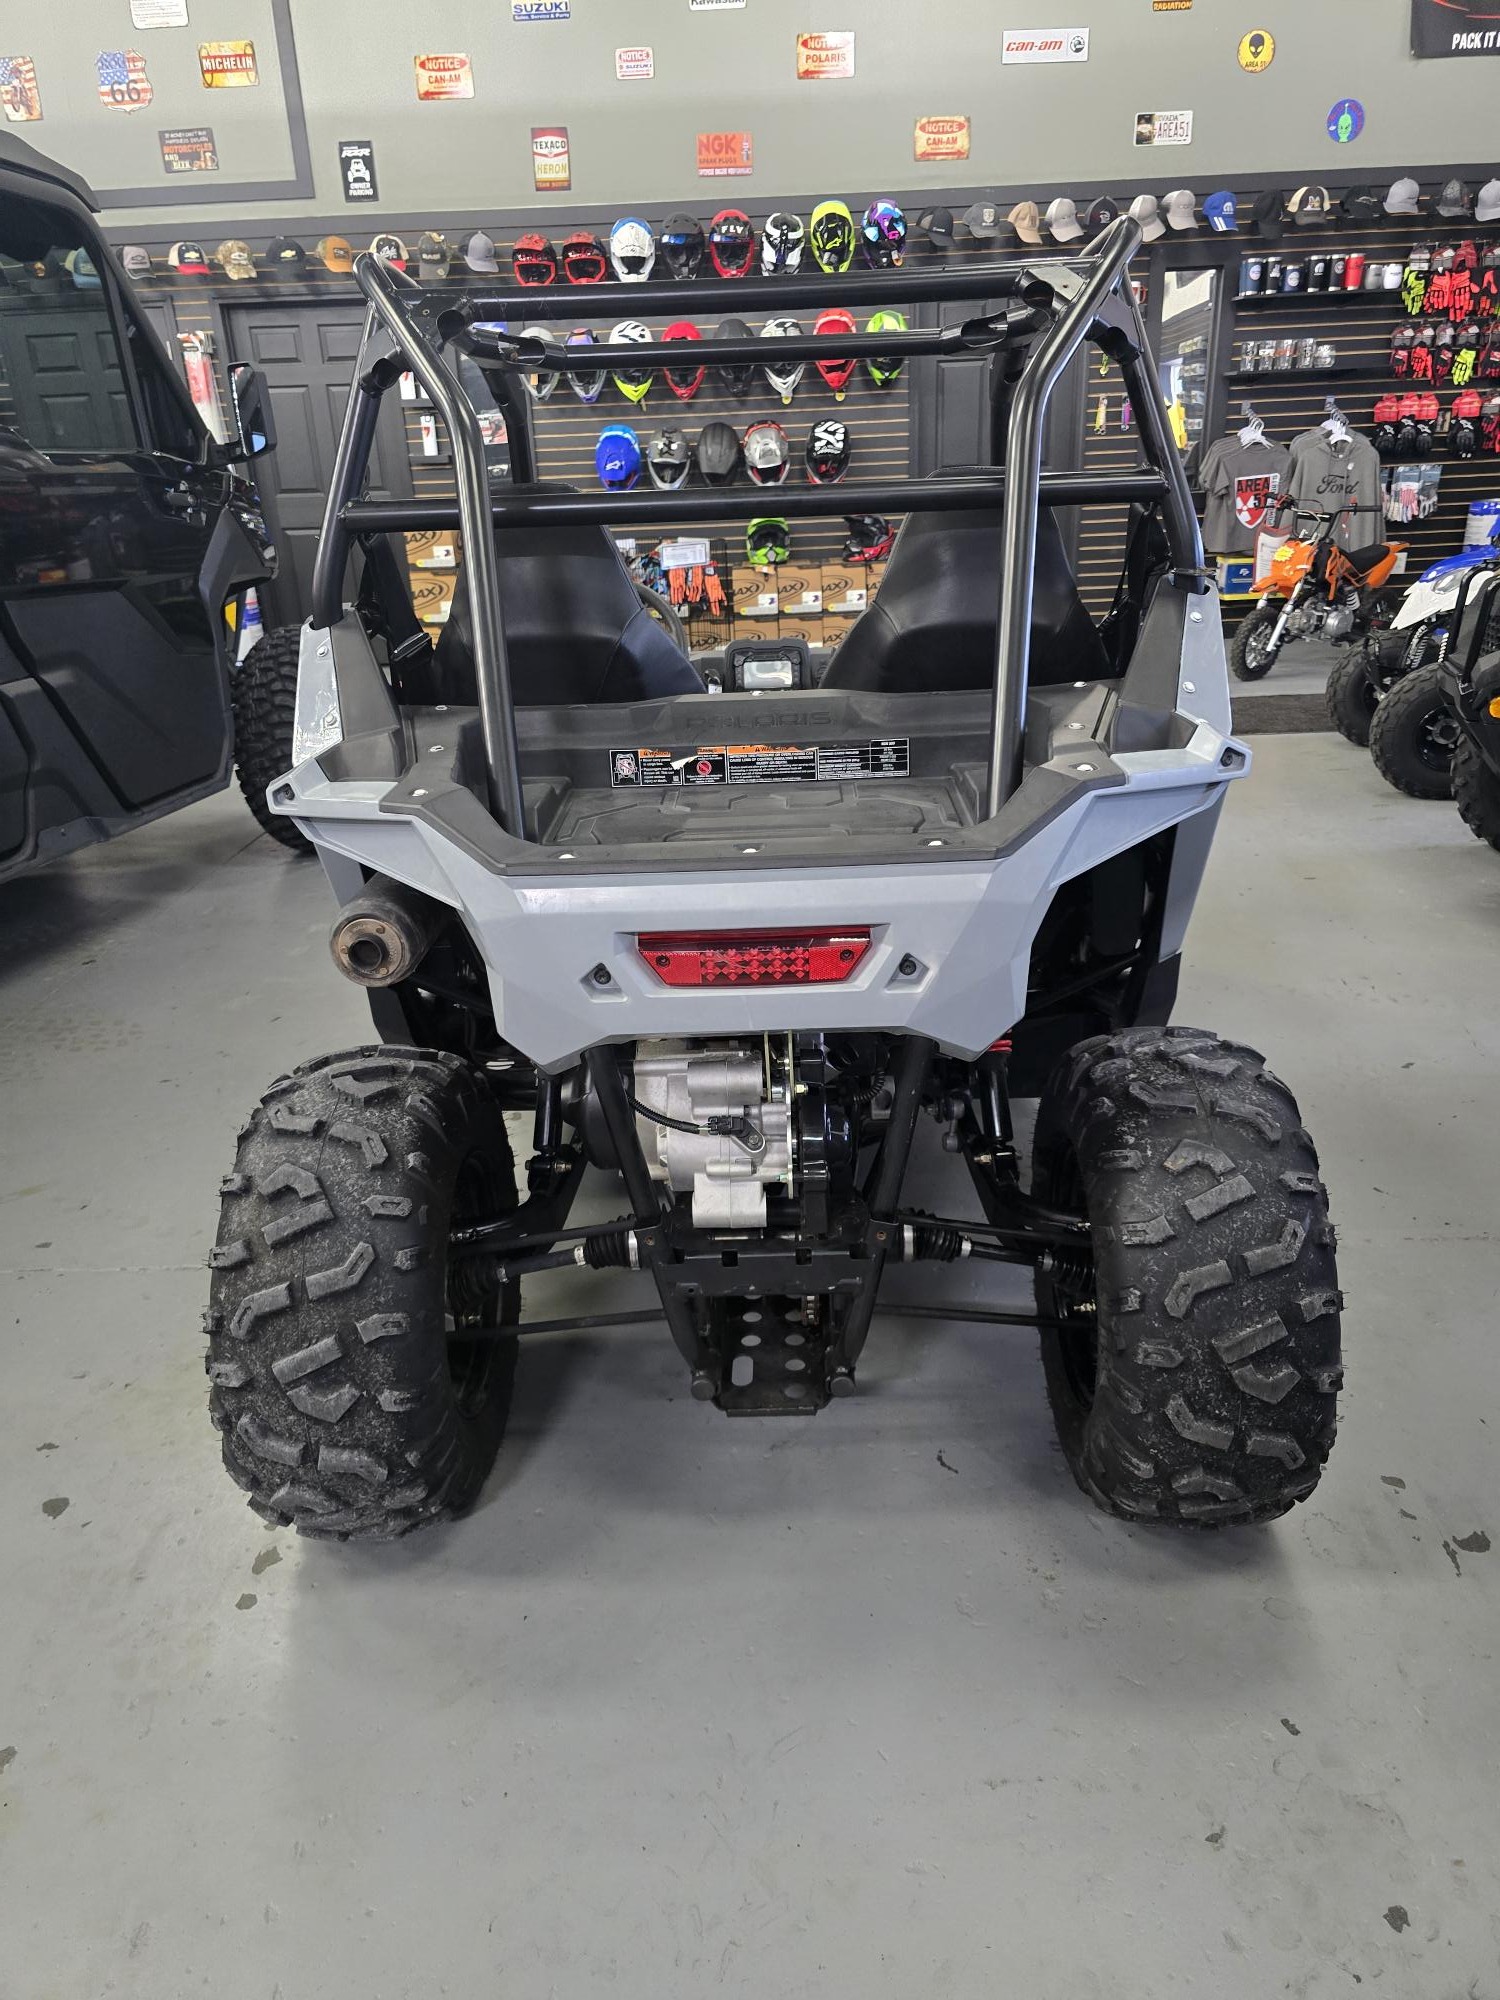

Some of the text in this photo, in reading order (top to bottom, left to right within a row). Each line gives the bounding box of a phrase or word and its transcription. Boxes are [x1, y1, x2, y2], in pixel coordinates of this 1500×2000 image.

[513, 1, 568, 13] SUZUKI
[1153, 1, 1192, 10] RADIATION
[1006, 40, 1063, 52] can-am
[1451, 32, 1483, 50] PACK
[1483, 31, 1496, 49] IT
[621, 51, 648, 61] NOTICE
[805, 53, 846, 64] POLARIS
[202, 57, 253, 71] MICHELIN
[425, 59, 460, 70] NOTICE
[428, 74, 461, 84] CAN-AM
[111, 79, 141, 103] 66
[925, 122, 959, 133] NOTICE
[1157, 121, 1189, 138] AREA51
[534, 140, 566, 150] TEXACO
[698, 134, 737, 156] NGK
[926, 136, 958, 146] CAN-AM
[165, 153, 179, 161] AND
[537, 163, 567, 175] HERON
[721, 225, 744, 234] FLY
[1237, 478, 1270, 492] AREA
[1316, 474, 1359, 494] Ford
[686, 711, 832, 729] POLARIS
